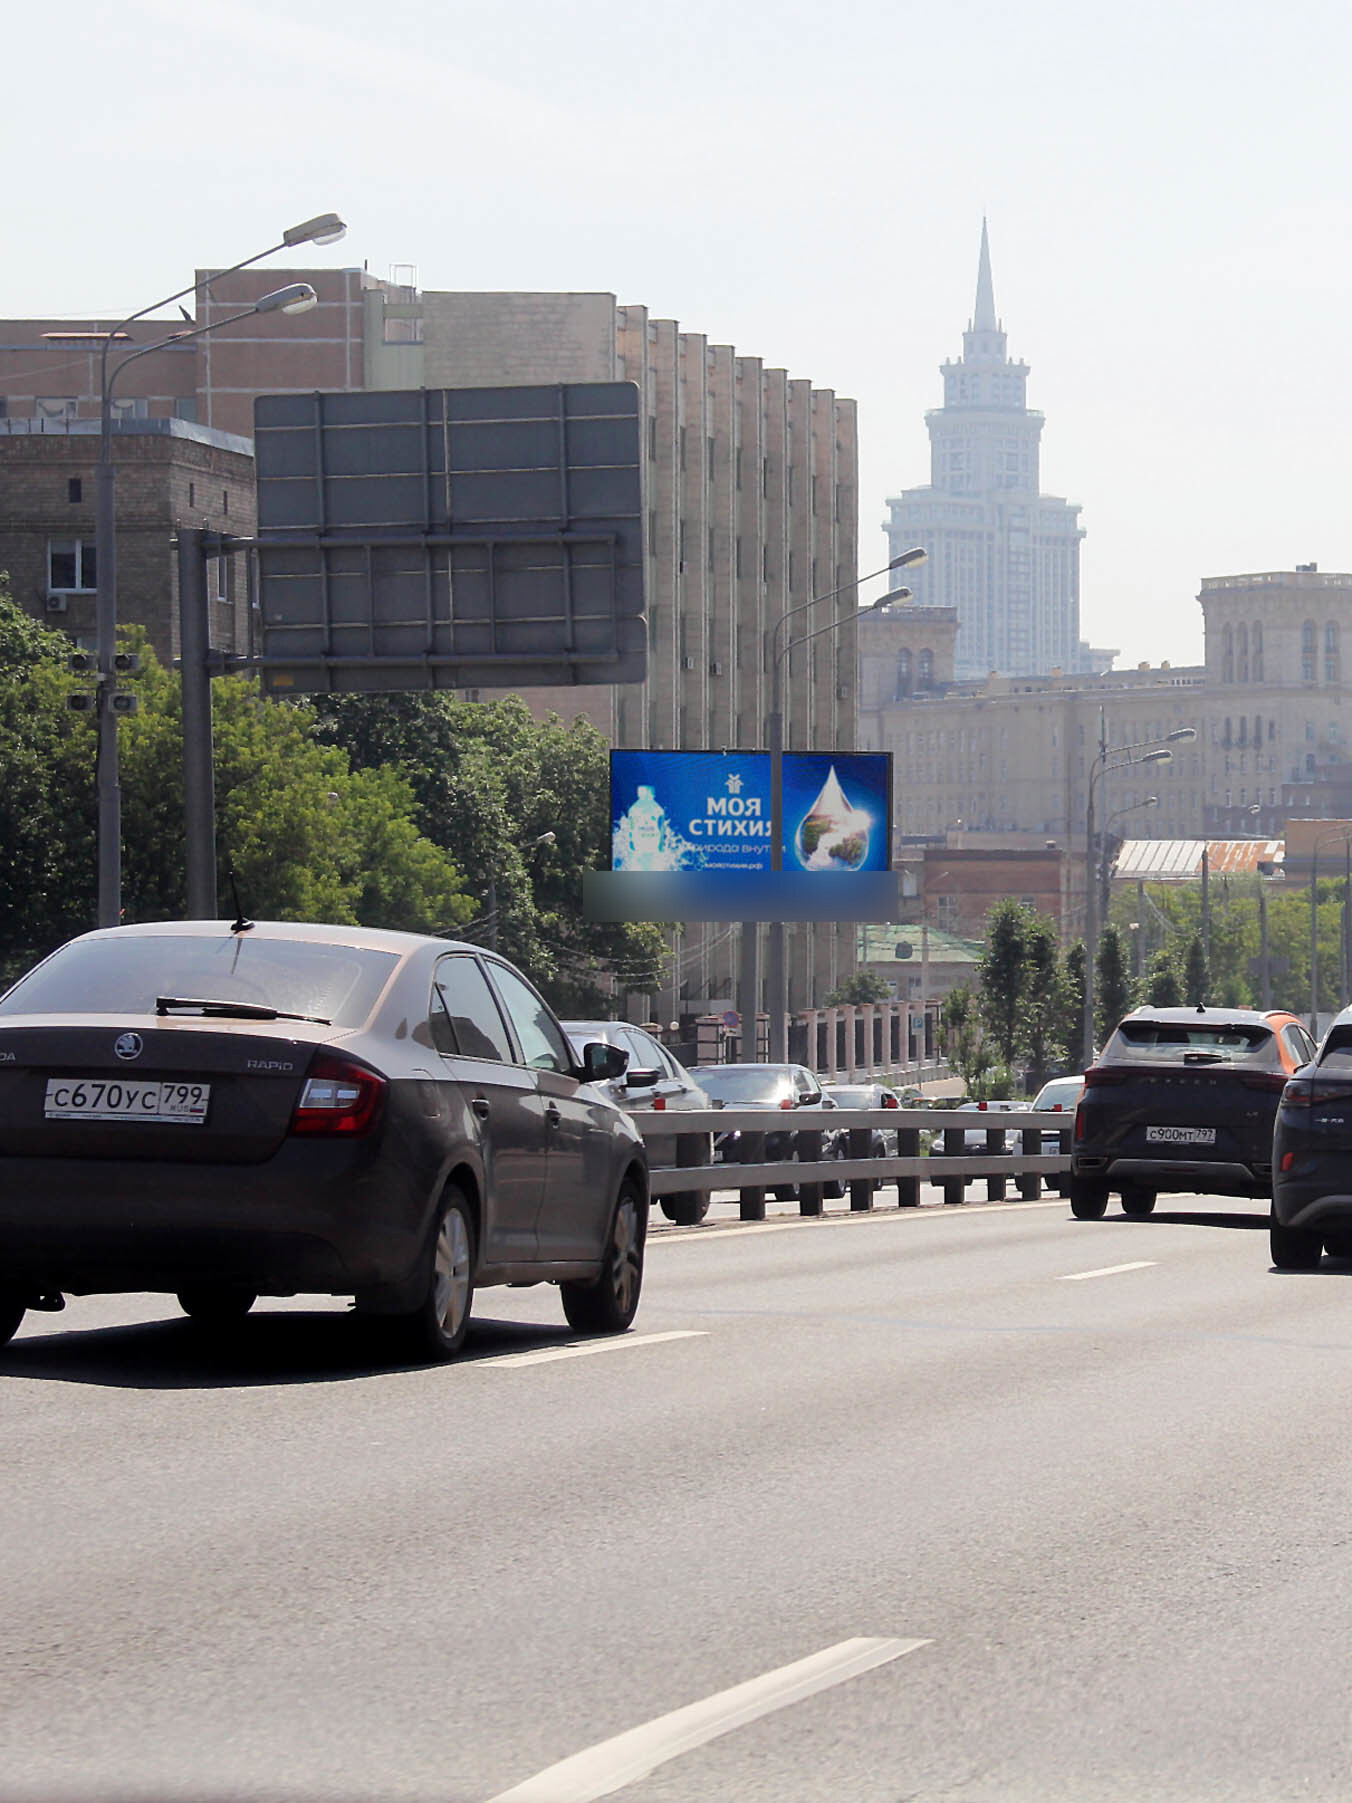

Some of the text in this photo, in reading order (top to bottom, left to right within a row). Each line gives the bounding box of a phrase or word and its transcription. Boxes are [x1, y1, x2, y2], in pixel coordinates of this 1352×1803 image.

[707, 797, 761, 816] МОЯ
[741, 843, 786, 855] внути
[247, 1059, 293, 1071] RAPID
